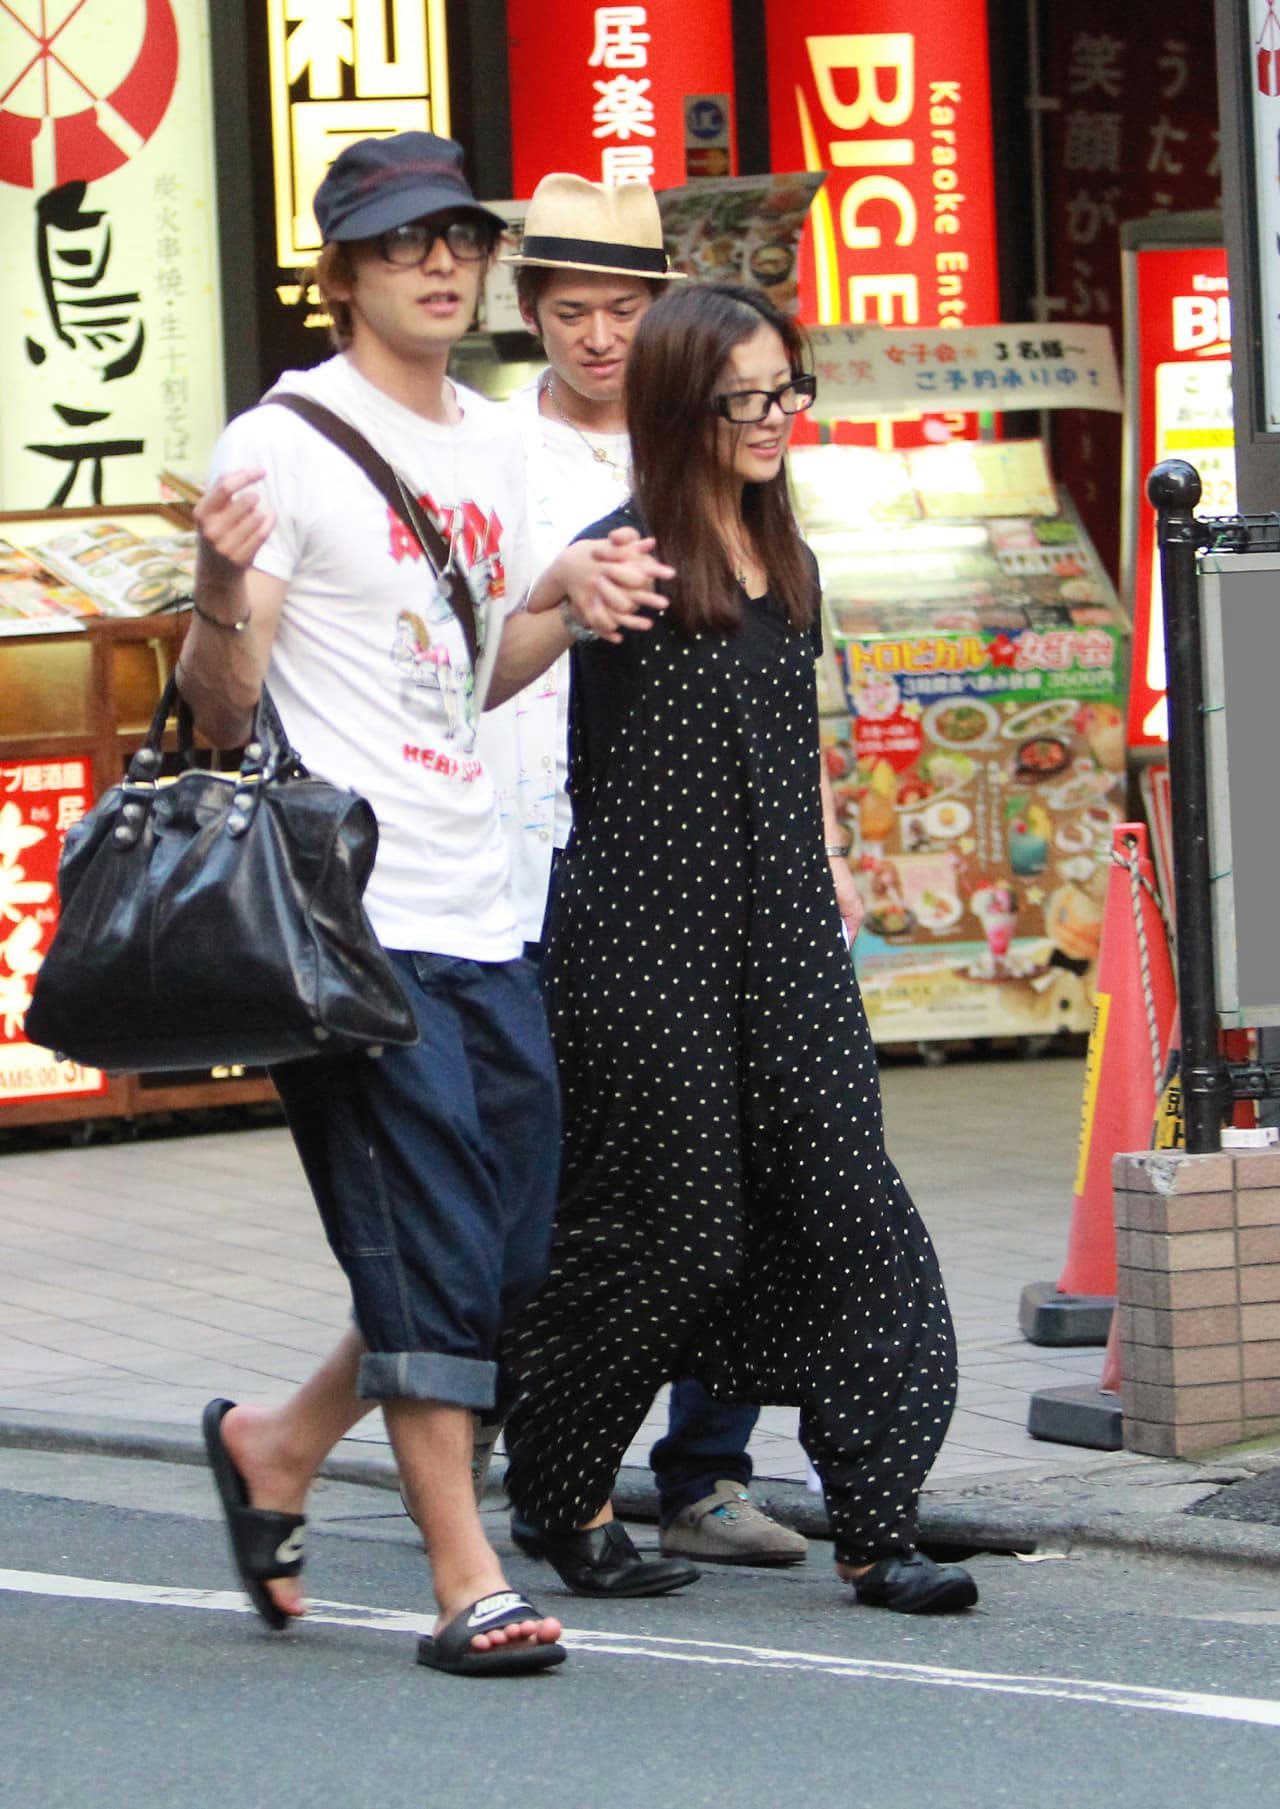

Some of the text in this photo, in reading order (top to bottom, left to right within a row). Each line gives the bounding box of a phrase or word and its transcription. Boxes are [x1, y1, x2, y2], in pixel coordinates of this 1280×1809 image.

[929, 81, 965, 235] Karaoke
[850, 636, 988, 673] トロピカル
